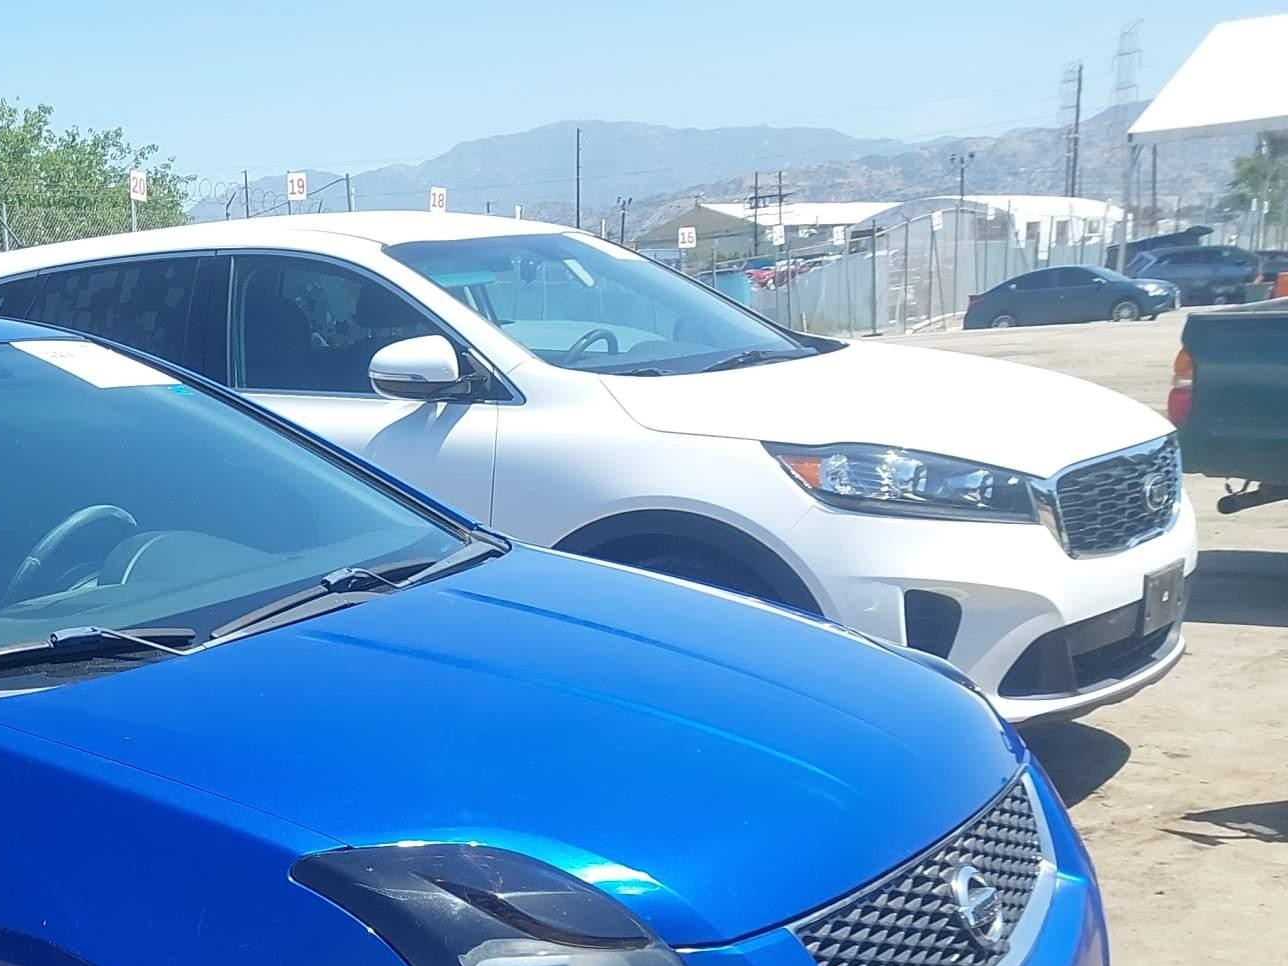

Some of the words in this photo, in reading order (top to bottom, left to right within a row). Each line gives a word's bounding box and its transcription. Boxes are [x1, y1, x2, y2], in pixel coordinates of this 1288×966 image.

[132, 176, 145, 195] 20
[288, 177, 305, 195] 19
[431, 192, 445, 209] 18
